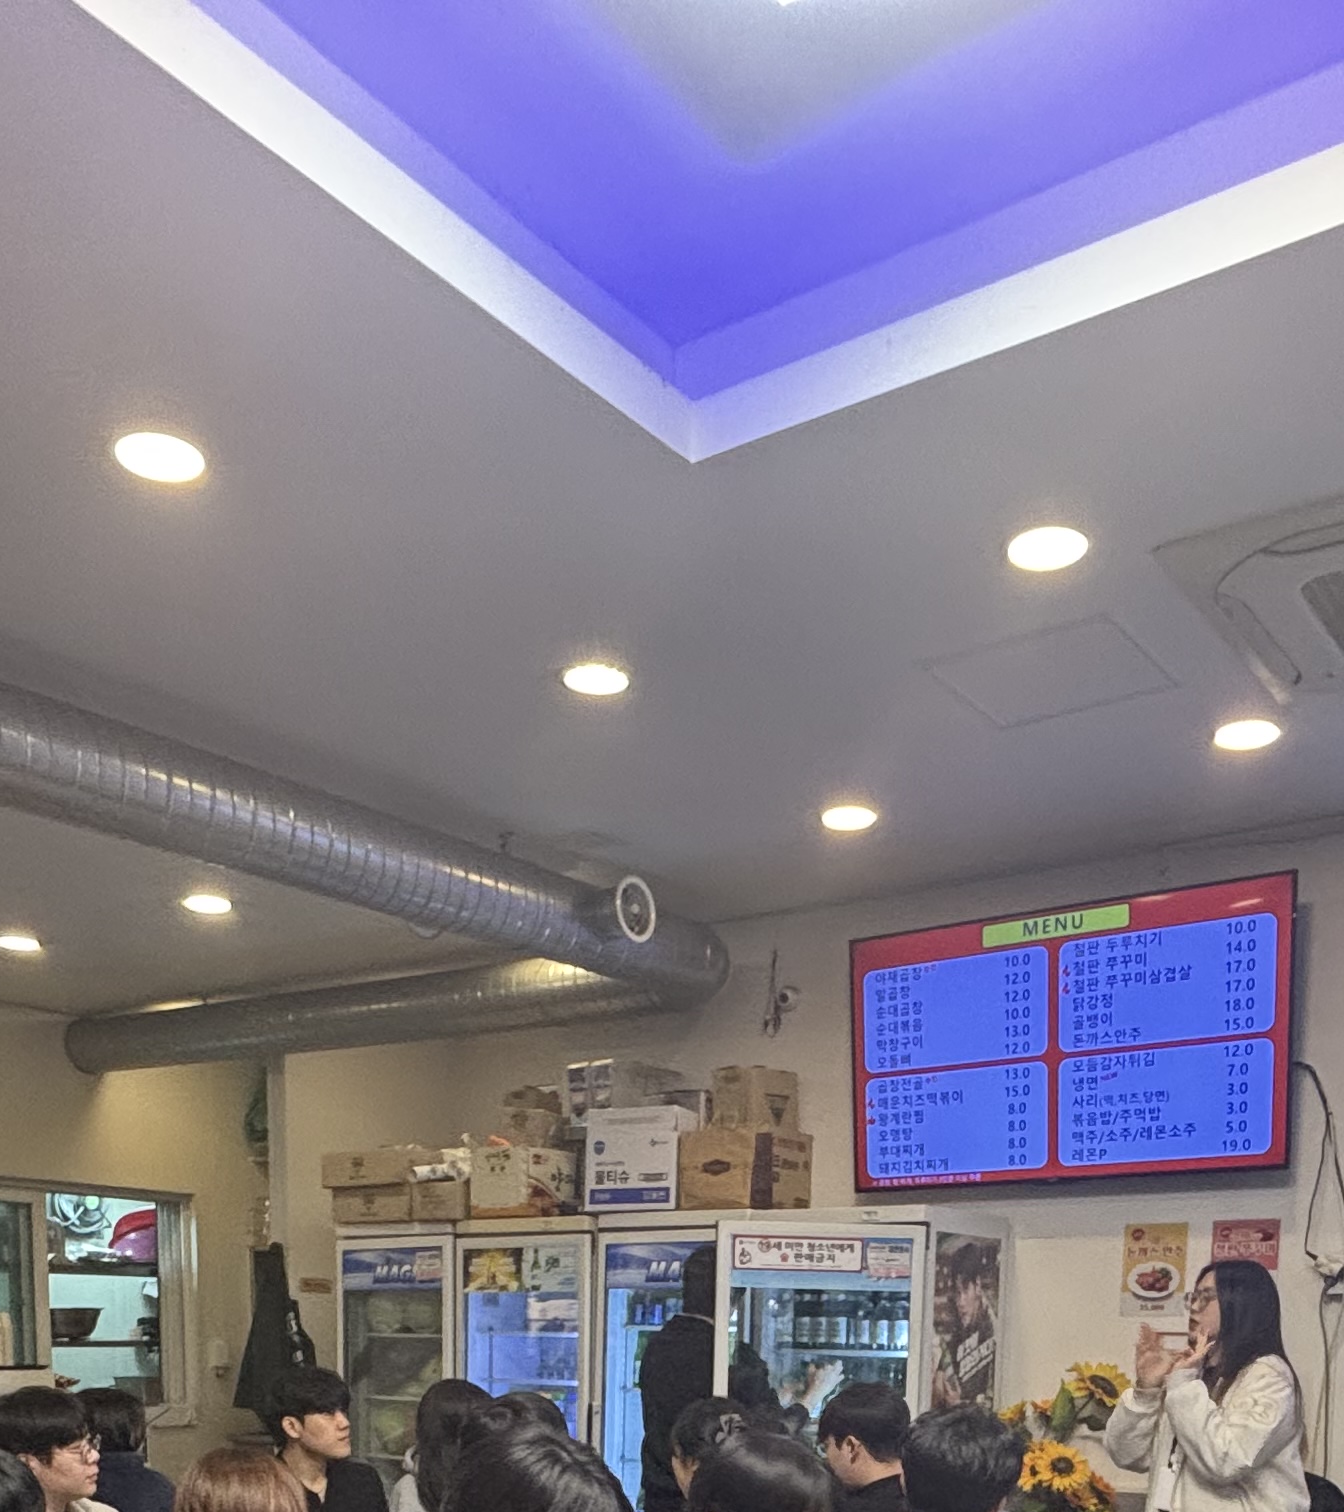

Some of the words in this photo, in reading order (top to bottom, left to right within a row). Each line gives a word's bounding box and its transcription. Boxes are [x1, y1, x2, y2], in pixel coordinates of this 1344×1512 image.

[1022, 913, 1086, 938] MENU
[1073, 942, 1100, 958] 철판
[1105, 932, 1163, 953] 두루치기
[1226, 919, 1257, 935] 10.0
[875, 967, 922, 985] 야채곱창
[1005, 953, 1031, 968] 10.0
[1072, 960, 1100, 976] 철판
[1226, 939, 1257, 954] 14.0
[1004, 971, 1031, 986] 12.0
[1072, 978, 1100, 995] 철판
[1225, 958, 1256, 974] 17.0
[876, 1001, 923, 1020] 순대곱창
[1004, 989, 1031, 1004] 12.0
[1072, 994, 1114, 1012] 닭강정
[1225, 978, 1256, 993] 17.0
[876, 1018, 923, 1037] 순대볶음
[1004, 1006, 1031, 1021] 10.0
[1072, 1013, 1114, 1030] 골뱅이
[1224, 997, 1255, 1013] 18.0
[876, 1035, 924, 1053] 막창구이
[1004, 1024, 1030, 1038] 13.0
[1072, 1027, 1142, 1049] 돈까스안주
[1224, 1016, 1254, 1031] 15.0
[1004, 1041, 1030, 1056] 12.0
[1072, 1052, 1156, 1074] 모듬감자튀김
[1223, 1044, 1254, 1058] 12.0
[877, 1076, 923, 1094] 곱창전골
[1004, 1067, 1030, 1080] 13.0
[1072, 1075, 1099, 1092] 냉면
[1227, 1063, 1249, 1077] 7.0
[1227, 1082, 1249, 1096] 3.0
[878, 1089, 964, 1110] 매운치즈떡볶이
[1004, 1084, 1031, 1098] 15.0
[878, 1110, 925, 1127] 왕계란찜
[1007, 1102, 1027, 1115] 8.0
[1072, 1106, 1161, 1127] 볶음밥/주먹밥
[1226, 1101, 1248, 1115] 3.0
[878, 1128, 913, 1142] 오뎅탕
[1007, 1120, 1027, 1132] 8.0
[1072, 1122, 1197, 1145] 맥주/소주/레몬소주
[1225, 1120, 1248, 1134] 5.0
[878, 1143, 925, 1159] 부대찌개
[1008, 1137, 1027, 1149] 8.0
[1072, 1148, 1107, 1162] 레몬P
[1222, 1138, 1252, 1152] 19.0
[878, 1158, 950, 1175] 돼지김치찌개
[1008, 1154, 1027, 1166] 8.0
